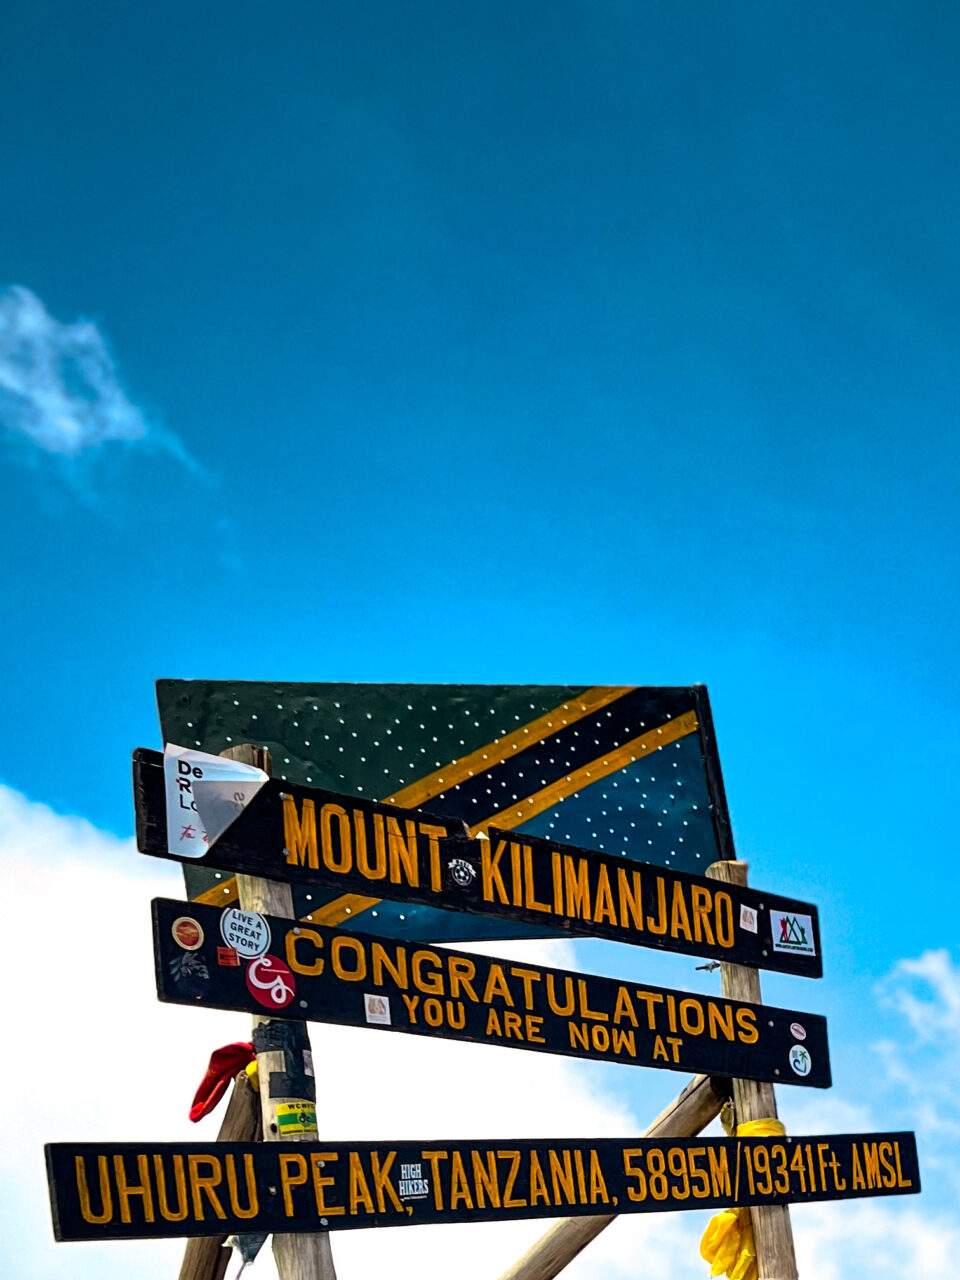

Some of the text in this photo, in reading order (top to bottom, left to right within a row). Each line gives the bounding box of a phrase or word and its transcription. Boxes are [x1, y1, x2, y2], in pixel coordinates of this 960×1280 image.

[283, 795, 735, 949] MOUNT KILIMANJARO
[231, 910, 262, 930] LIVE A
[230, 921, 262, 941] GREAT
[228, 932, 260, 952] STORY
[285, 928, 759, 1045] CONGRATULATIONS
[402, 994, 683, 1063] YOU ARE NOW AT
[400, 1163, 422, 1180] HIGH
[75, 1154, 259, 1224] UHURU
[279, 1151, 413, 1217] PEAK,
[421, 1150, 618, 1211] TANZANIA,
[852, 1141, 912, 1190] AMSL
[398, 1179, 429, 1196] HIKERS
